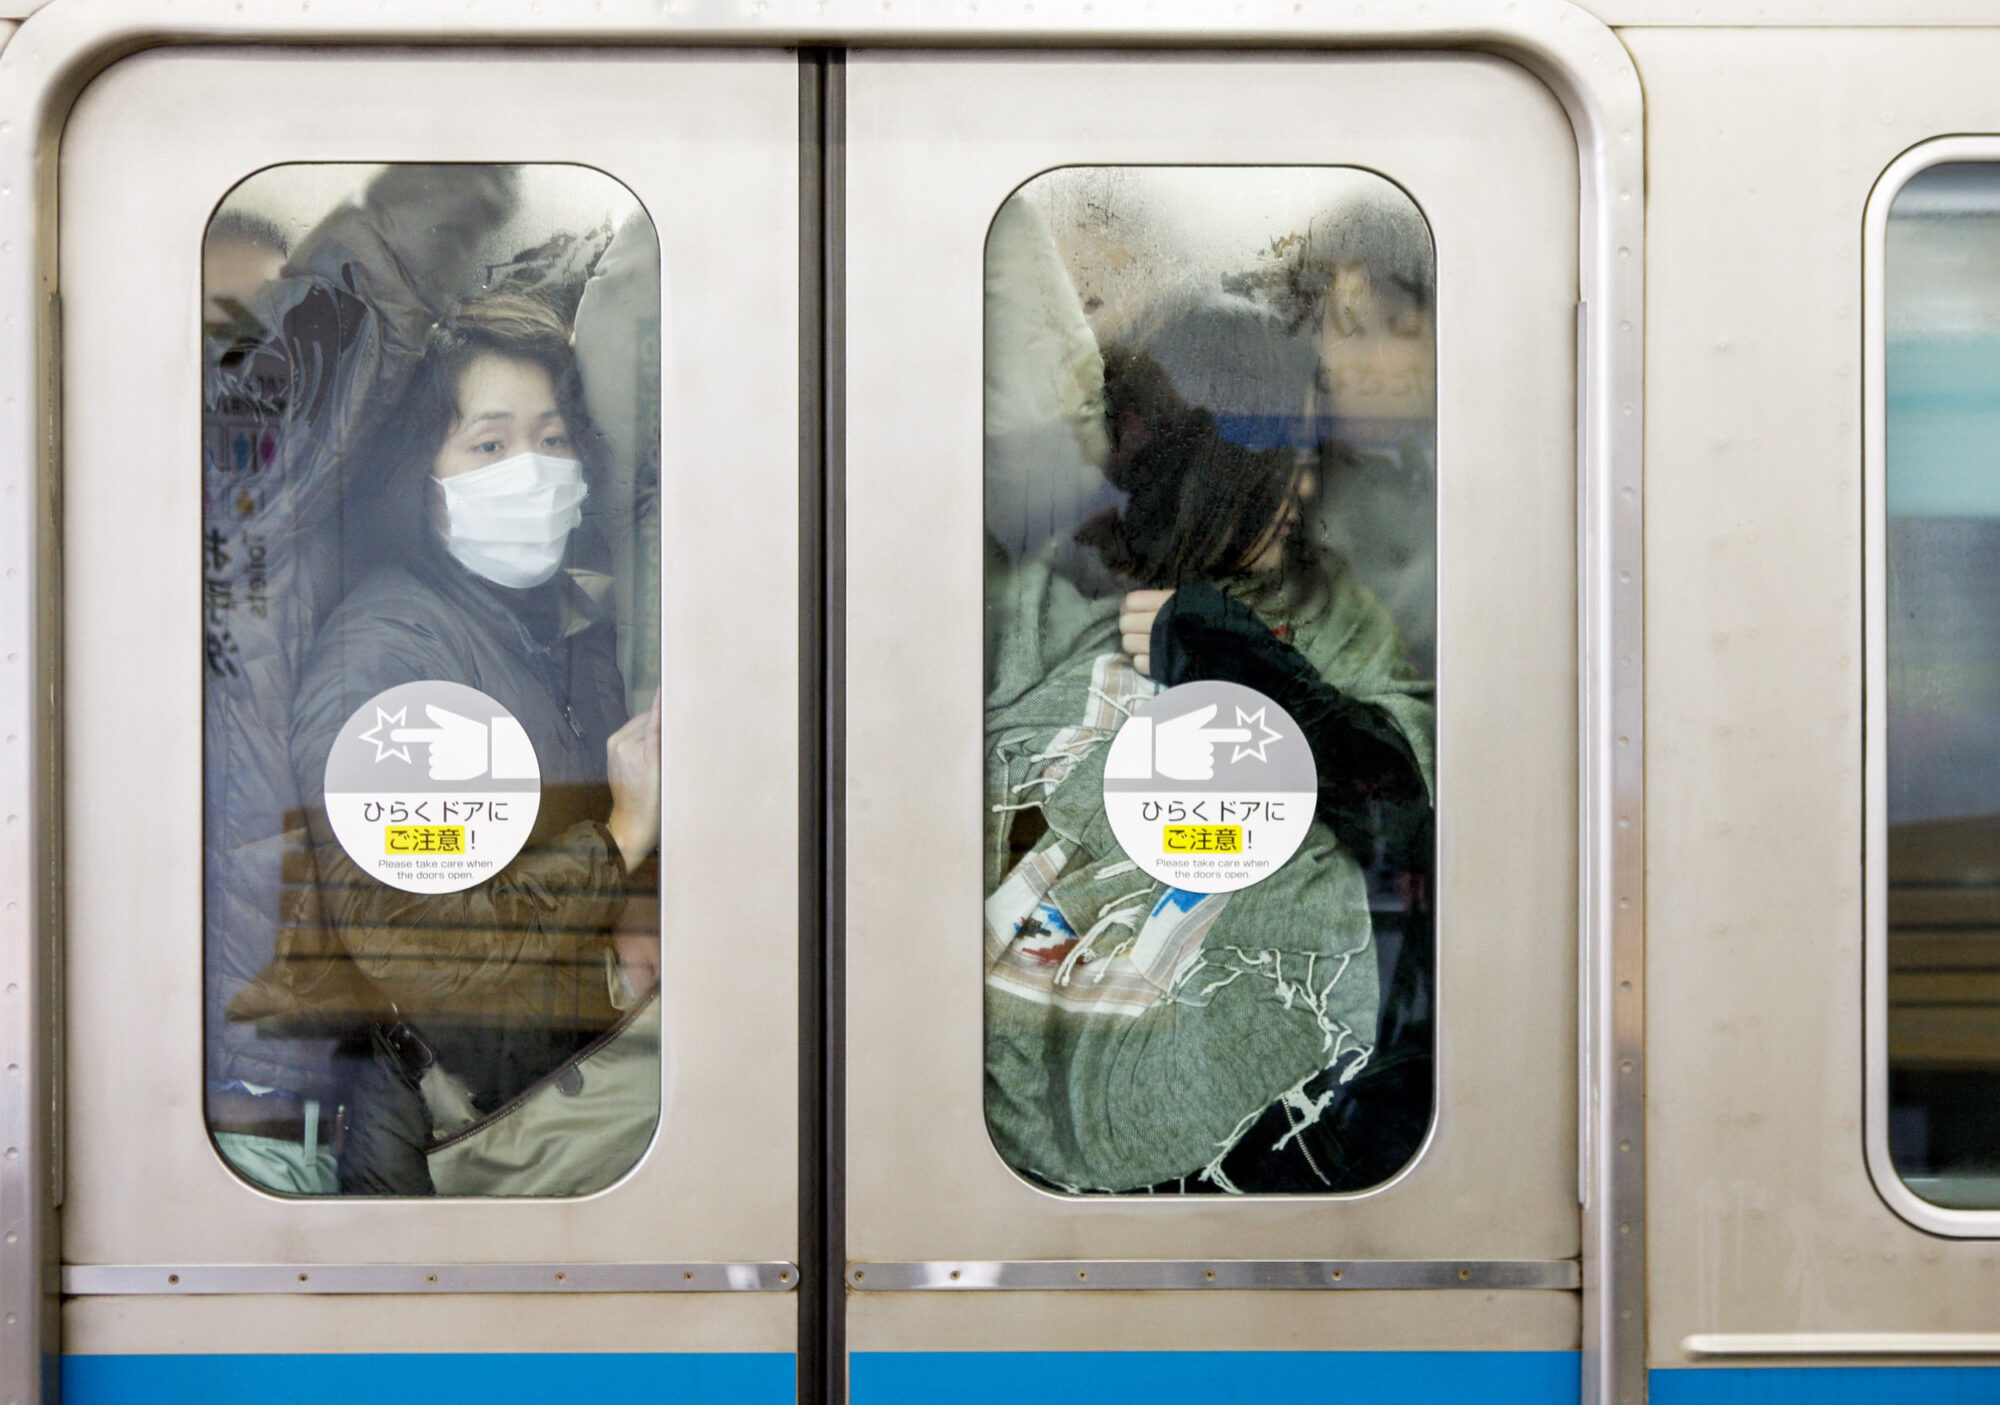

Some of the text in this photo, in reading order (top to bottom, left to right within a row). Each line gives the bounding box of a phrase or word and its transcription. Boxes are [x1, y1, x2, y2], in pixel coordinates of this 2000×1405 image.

[363, 800, 509, 822] ひらくドアに
[1142, 800, 1285, 822] ひらくドアに
[378, 859, 493, 869] Please take care when
[1156, 858, 1270, 868] Please take care when
[397, 871, 413, 880] the
[416, 871, 445, 880] doors
[1174, 870, 1190, 879] the
[1192, 870, 1221, 879] doors
